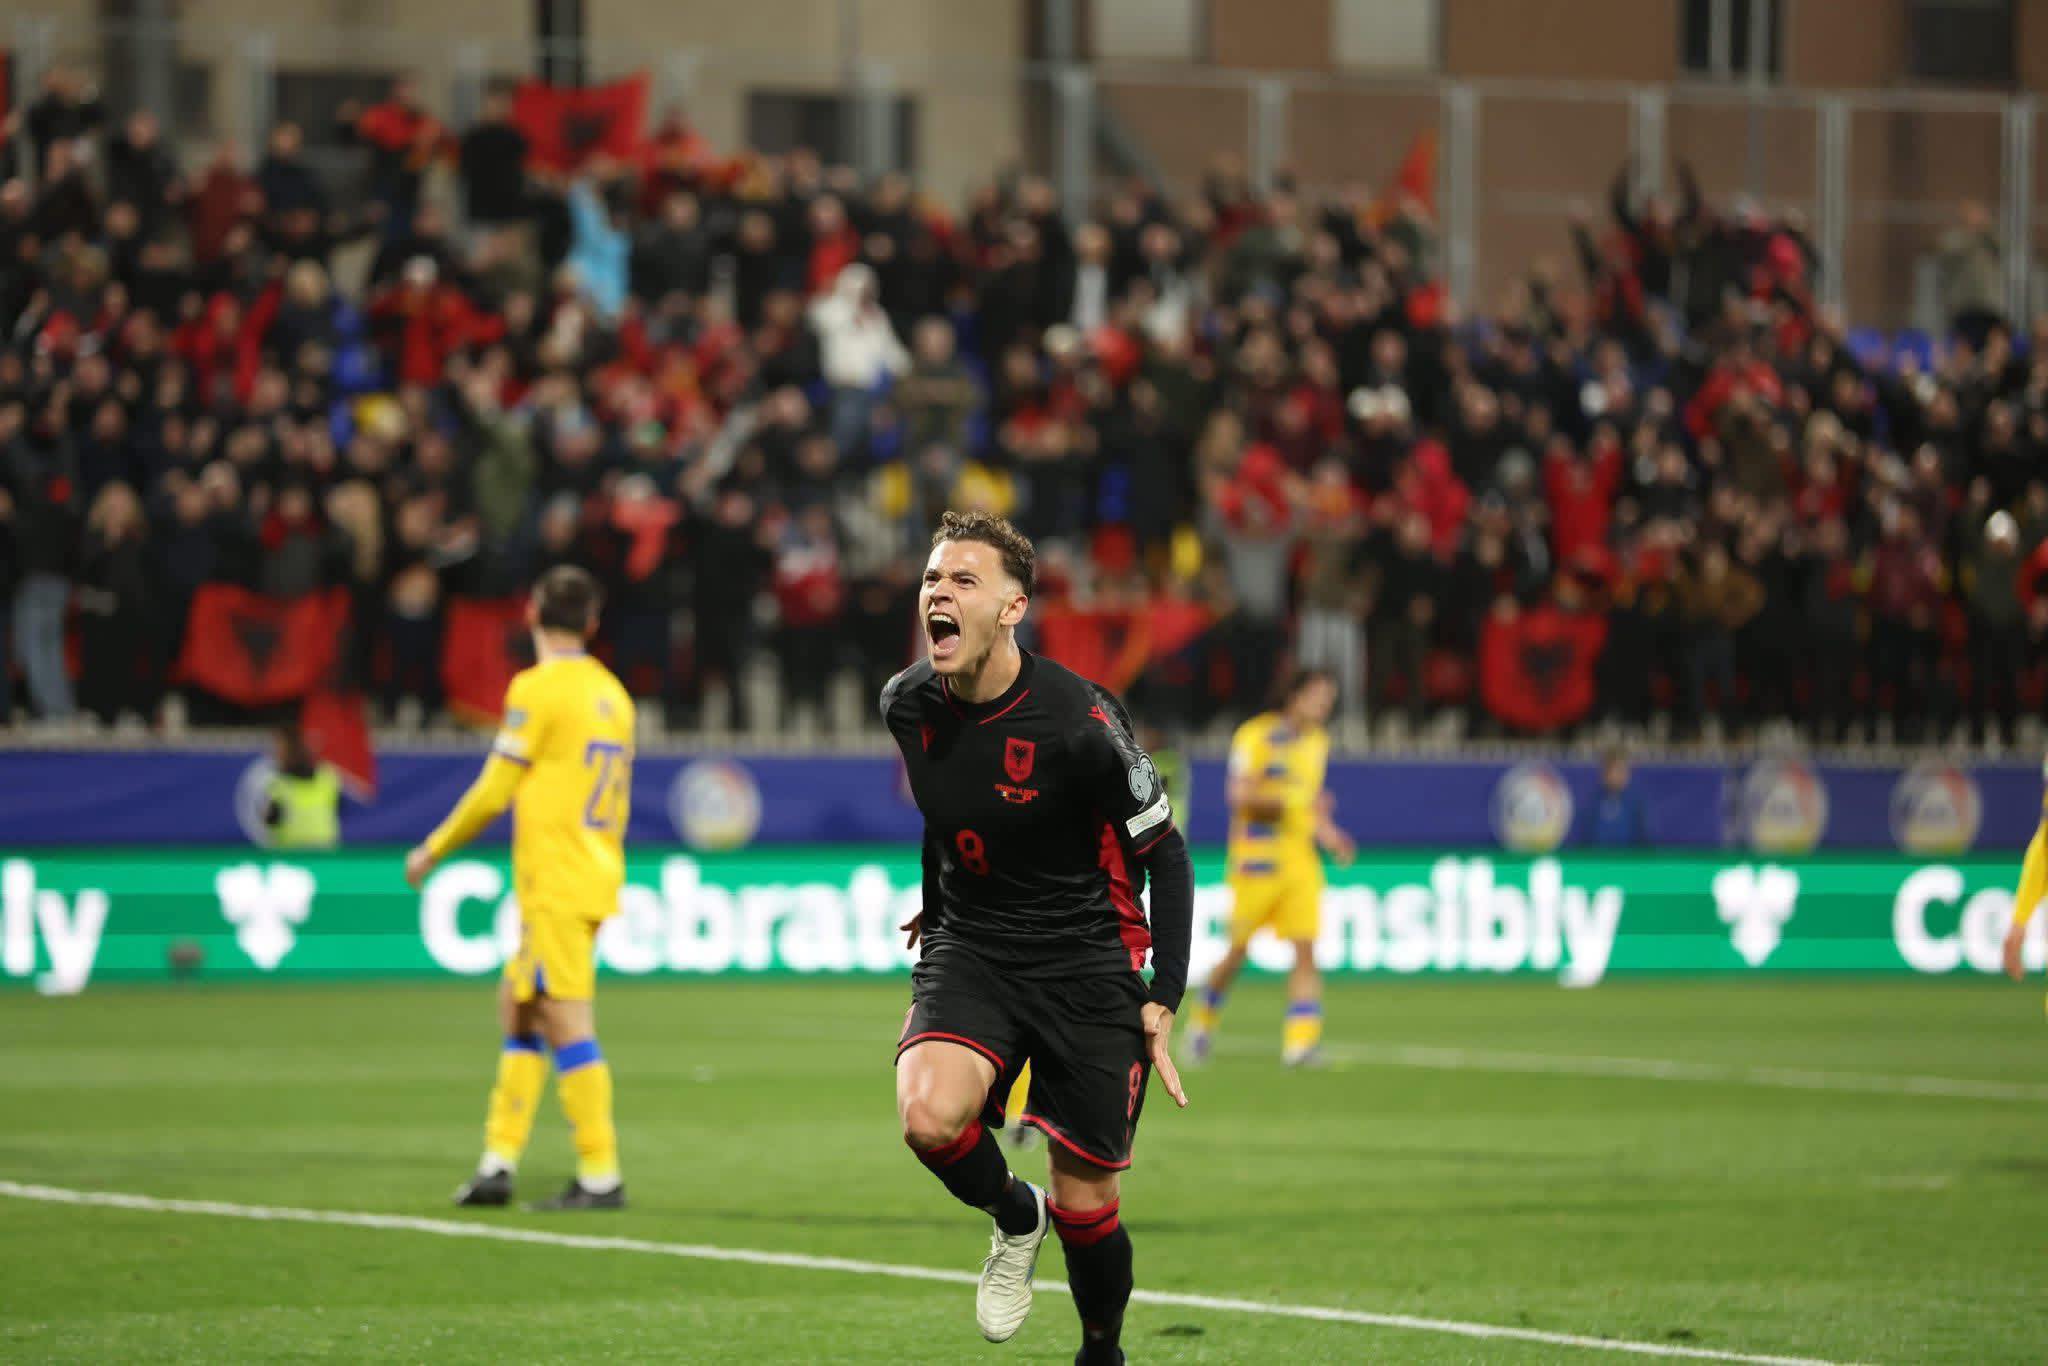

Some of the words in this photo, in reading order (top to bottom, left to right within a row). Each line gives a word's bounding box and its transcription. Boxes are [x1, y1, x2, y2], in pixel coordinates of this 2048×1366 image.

[584, 741, 634, 828] 2
[955, 829, 990, 876] 8
[419, 857, 922, 974] Cebrat
[1139, 857, 1622, 988] pnsibly
[1127, 1060, 1143, 1121] 8
